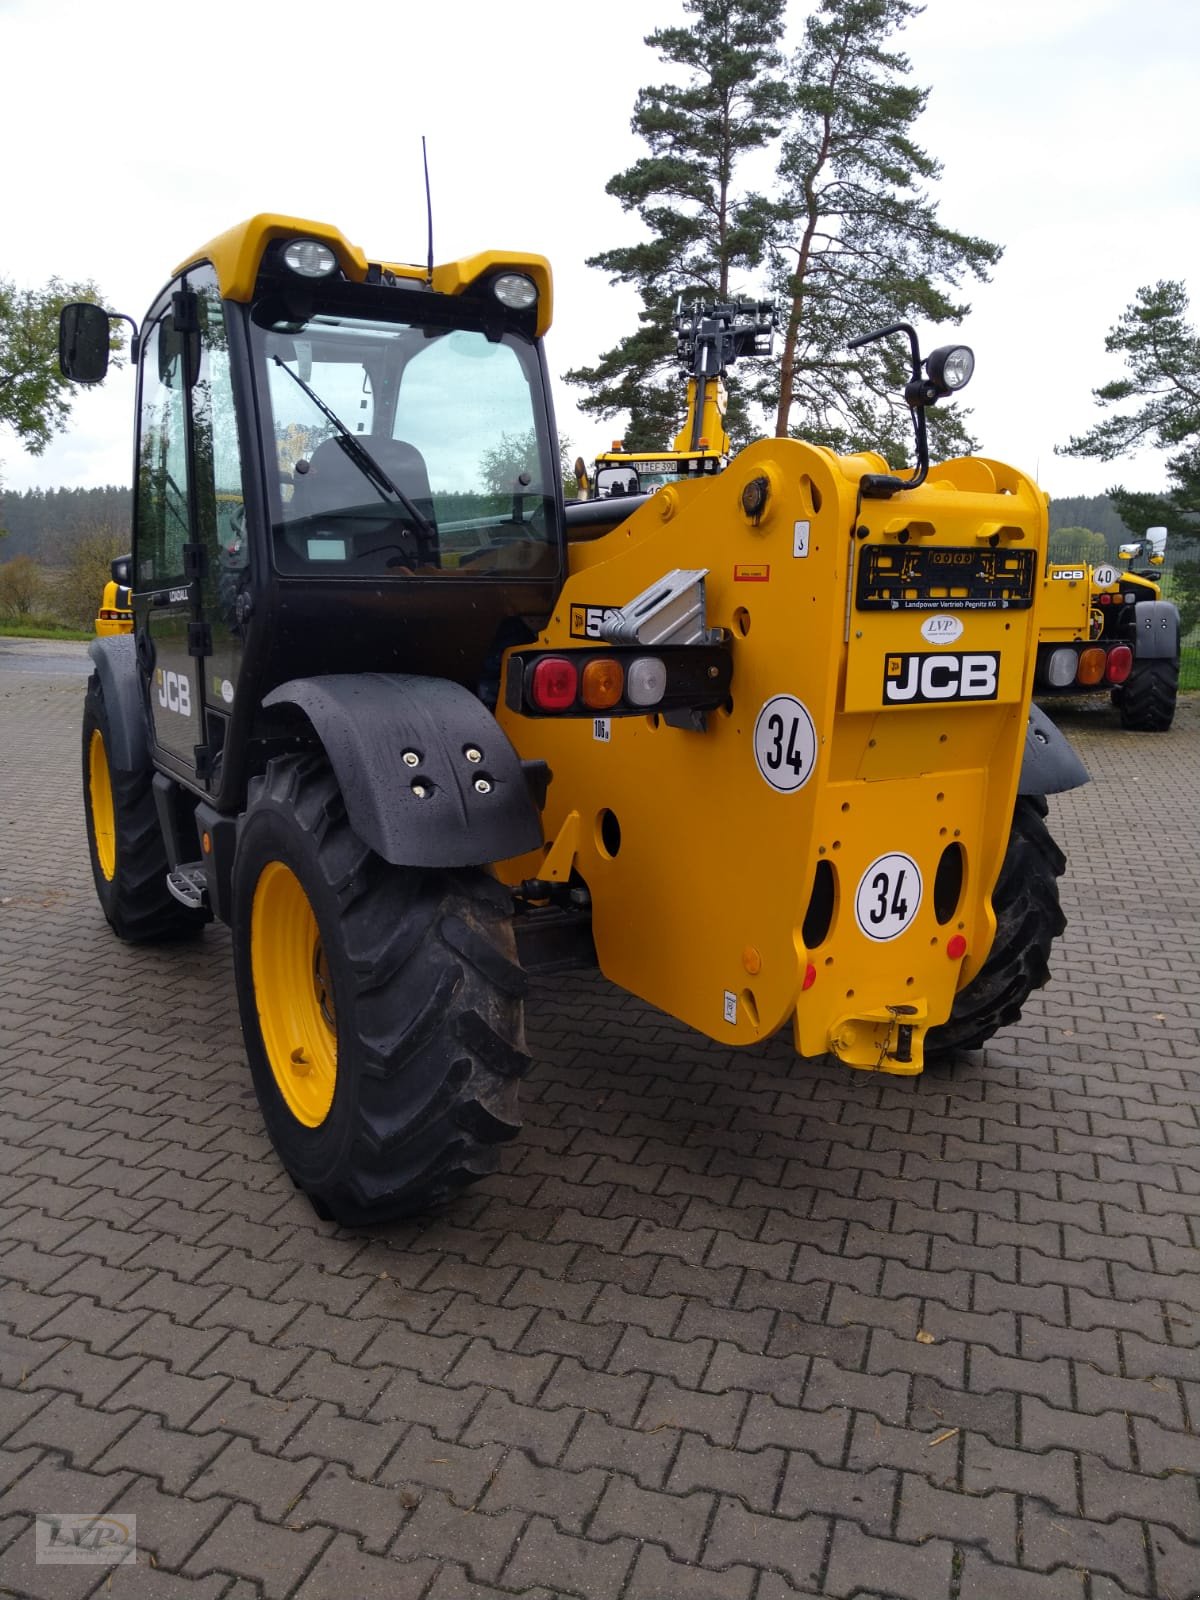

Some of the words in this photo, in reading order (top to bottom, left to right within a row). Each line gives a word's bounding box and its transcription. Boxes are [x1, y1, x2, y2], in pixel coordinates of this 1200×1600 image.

[650, 463, 660, 472] EF
[662, 463, 676, 472] 390
[1053, 570, 1084, 580] JCB
[1097, 570, 1112, 583] 40
[927, 620, 953, 632] LVP
[886, 655, 997, 700] JCB
[158, 670, 192, 717] JCB
[766, 713, 803, 776] 34
[869, 869, 908, 924] 34
